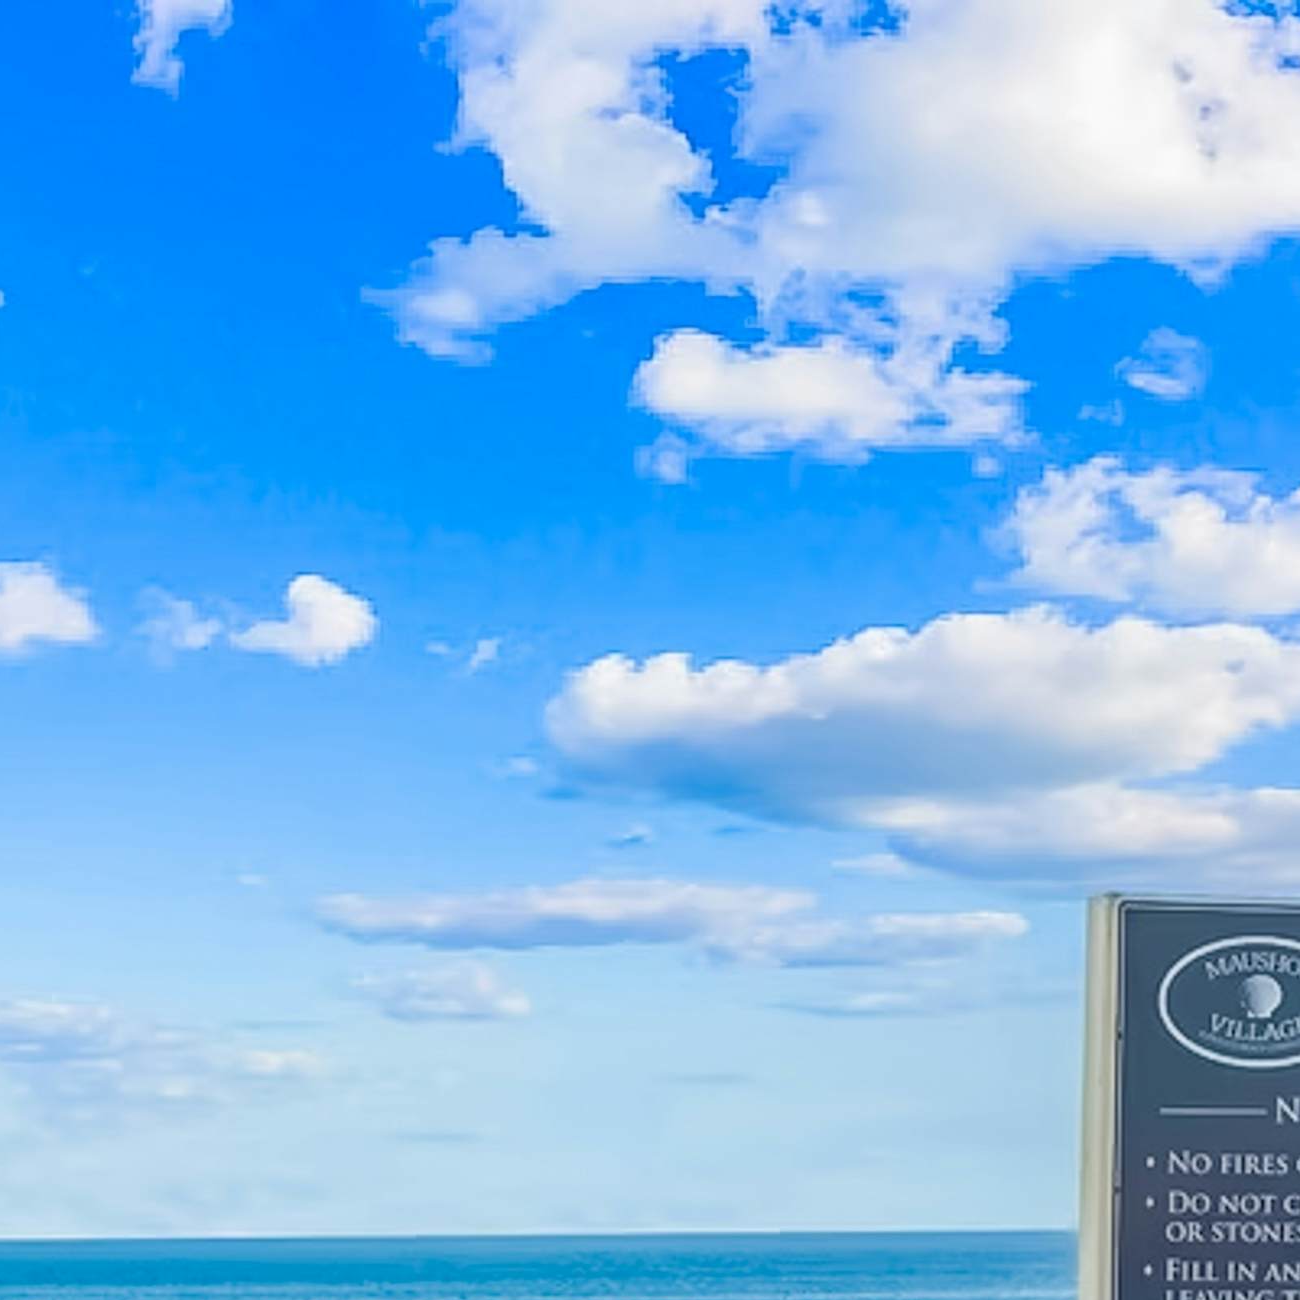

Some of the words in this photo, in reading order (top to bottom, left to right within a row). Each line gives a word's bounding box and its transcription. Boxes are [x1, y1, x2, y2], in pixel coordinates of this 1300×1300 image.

[1221, 1153, 1289, 1175] FIRES
[1218, 1193, 1278, 1216] NOT
[1165, 1221, 1205, 1243] OR
[1227, 1261, 1258, 1282] IN
